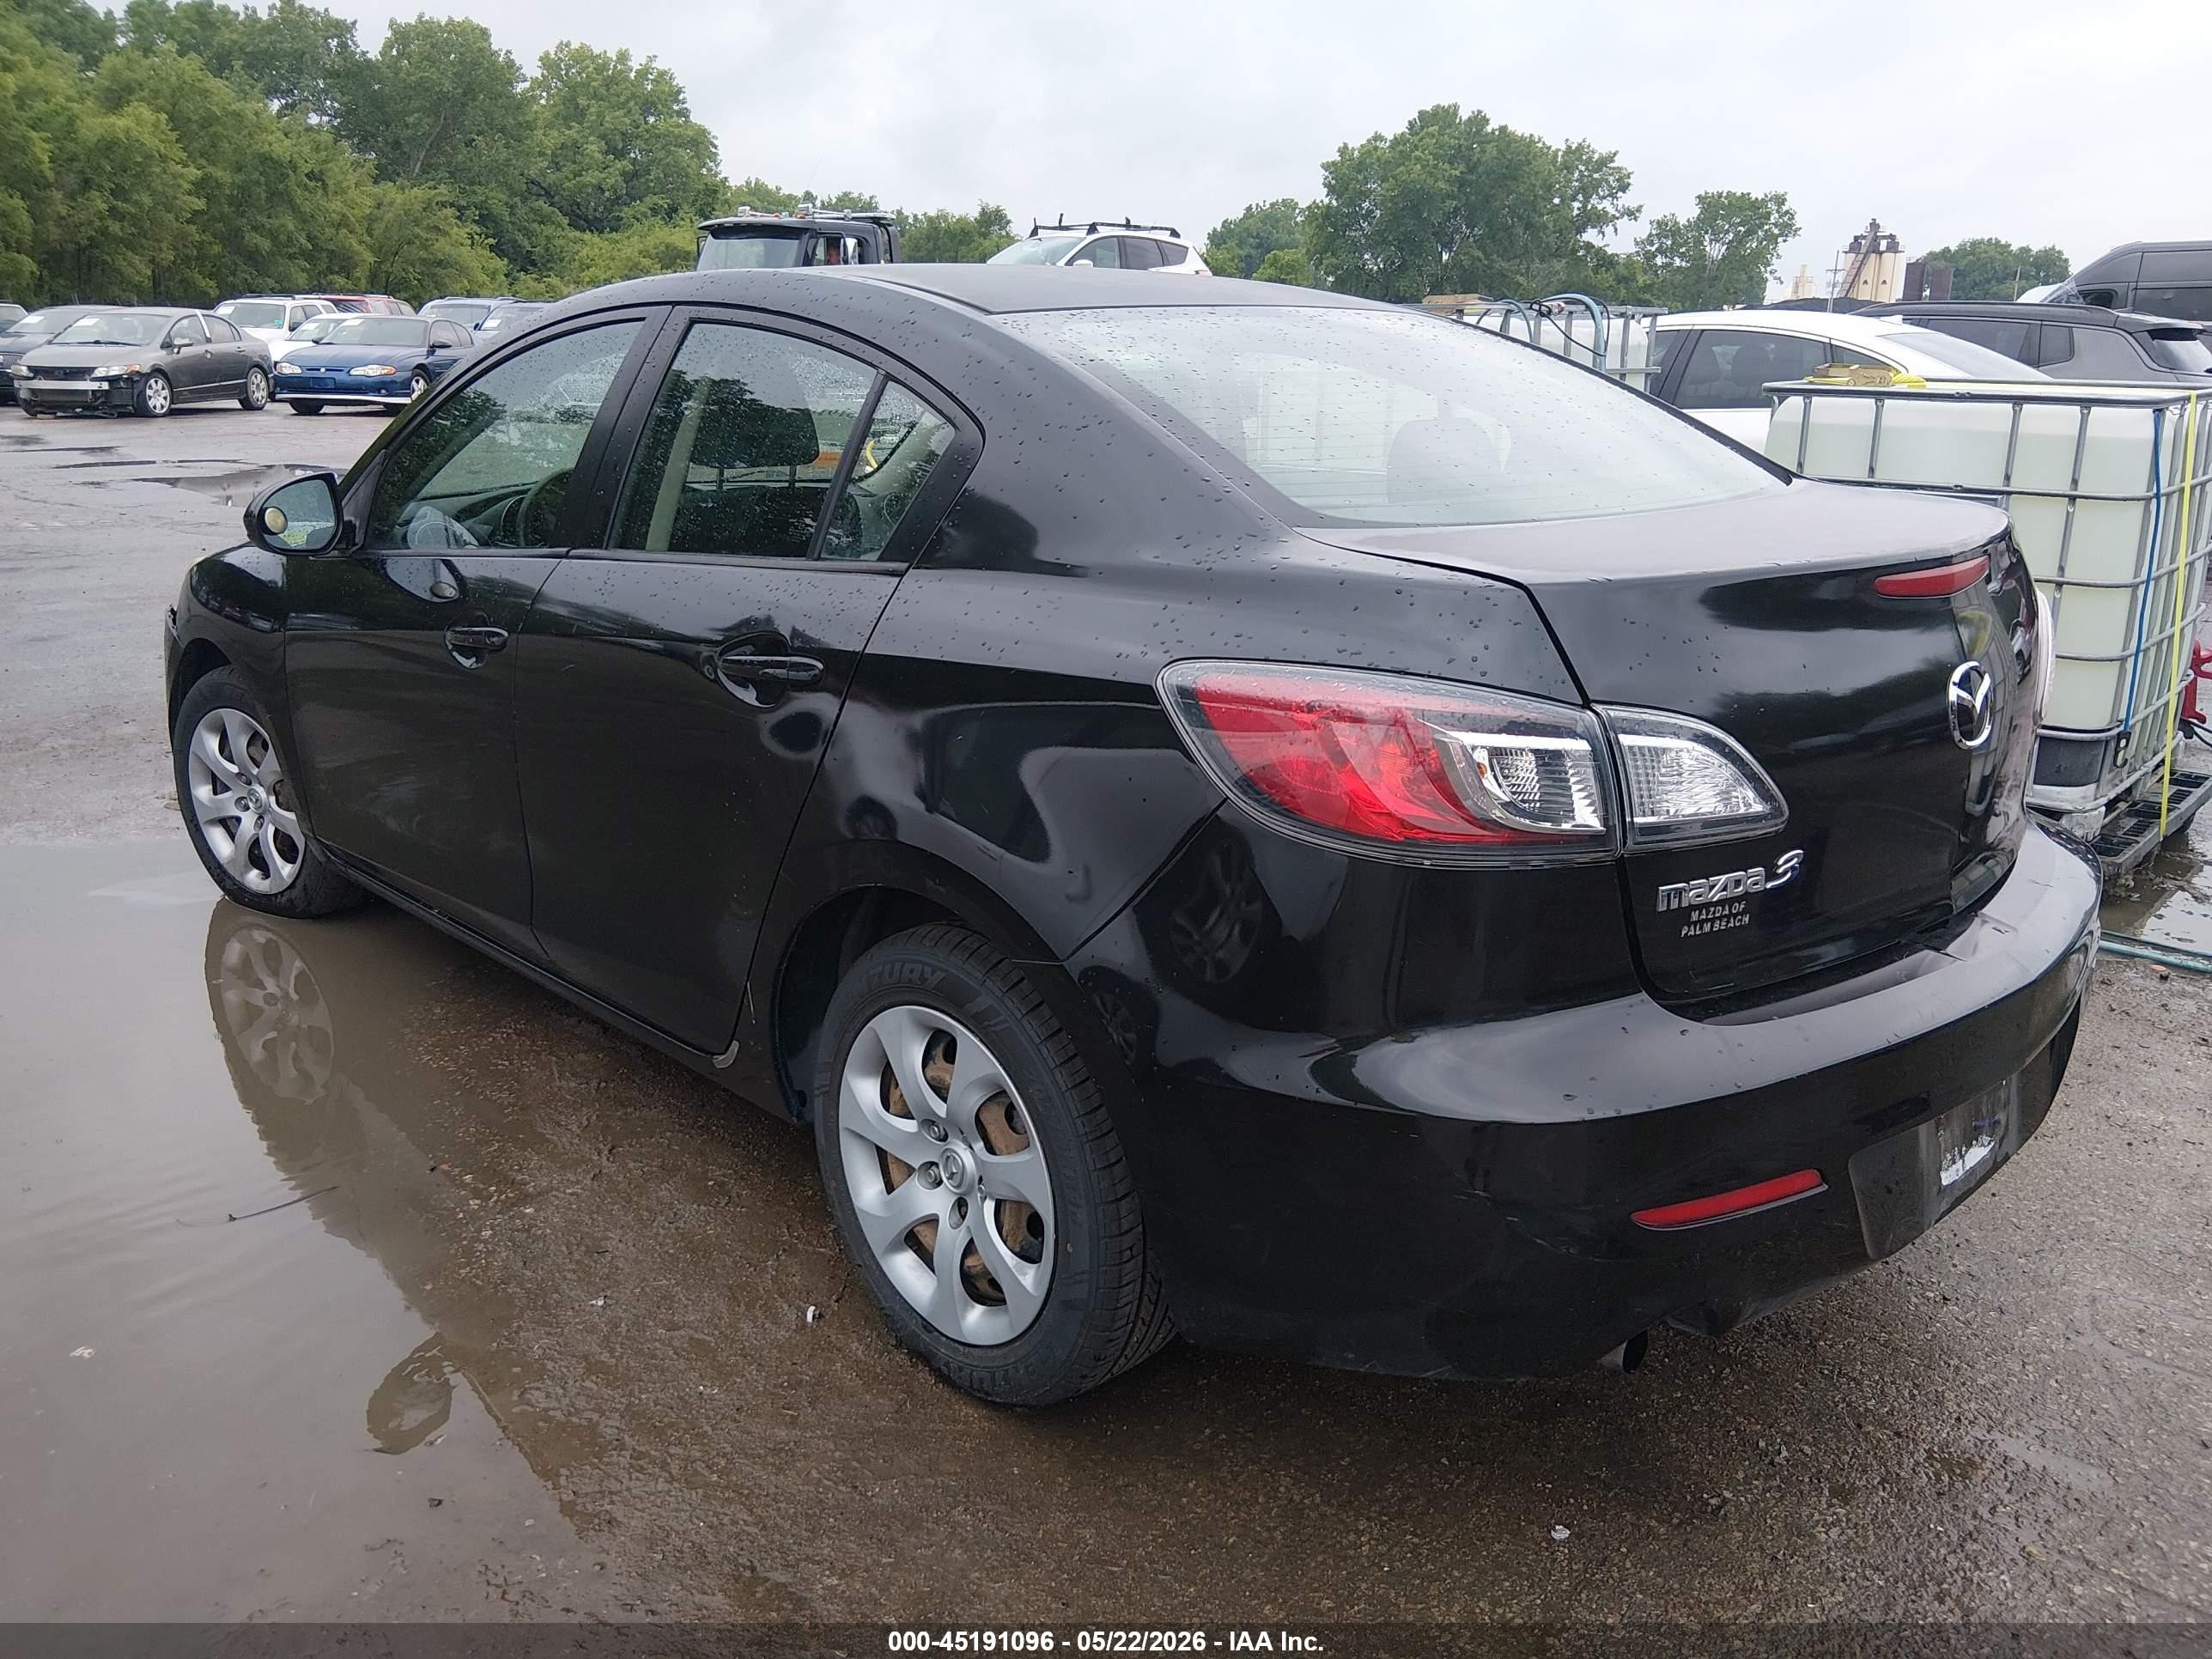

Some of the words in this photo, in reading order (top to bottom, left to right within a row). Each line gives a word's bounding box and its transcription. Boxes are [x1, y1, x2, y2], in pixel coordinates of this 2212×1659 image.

[1690, 904, 1729, 921] MAZDA
[1731, 901, 1747, 914] OF
[1680, 922, 1711, 937] PALM
[1713, 914, 1749, 931] BEACH
